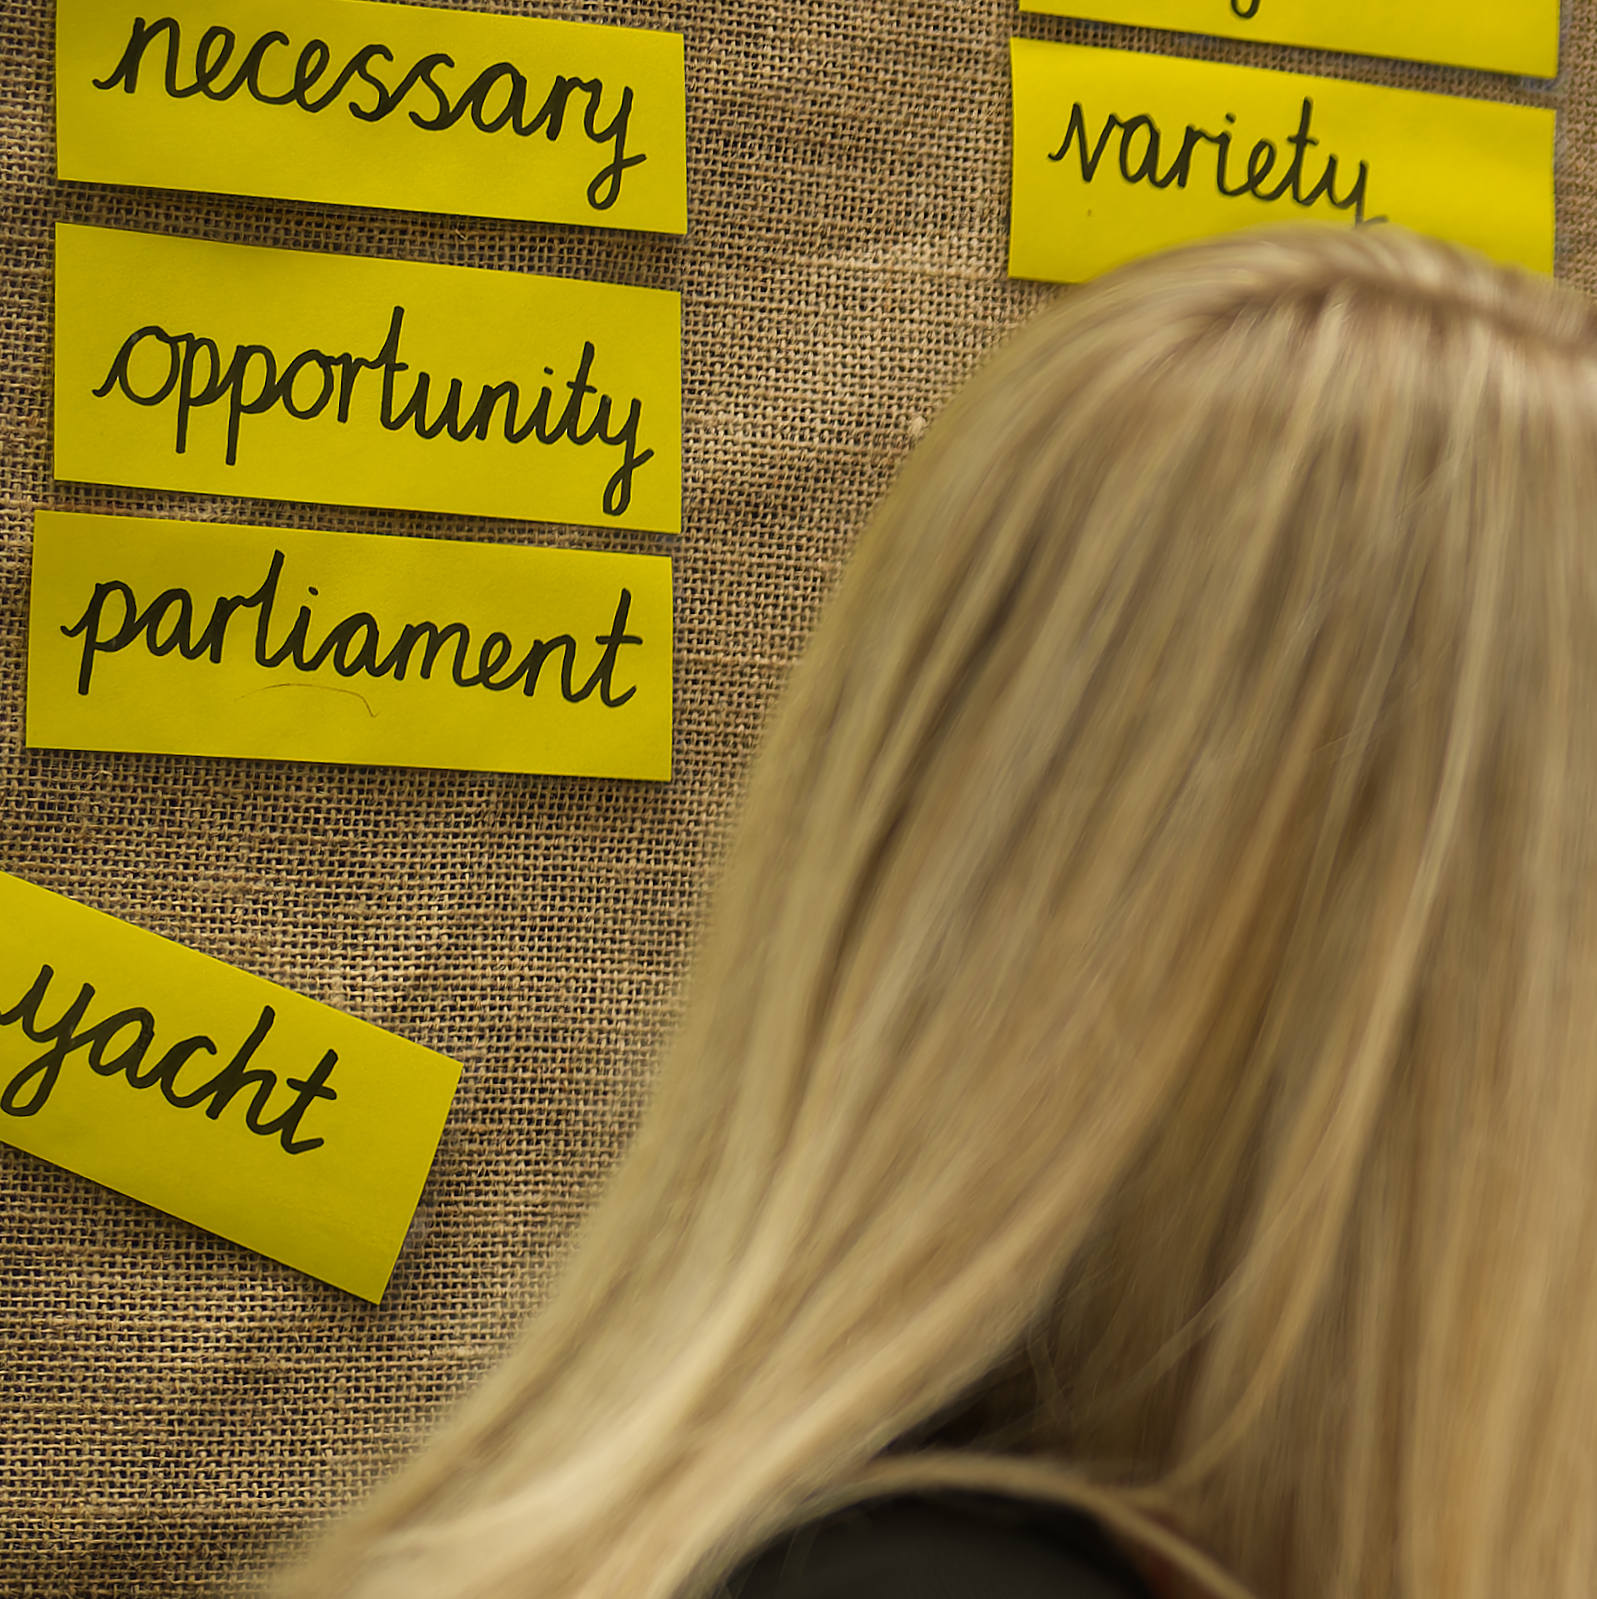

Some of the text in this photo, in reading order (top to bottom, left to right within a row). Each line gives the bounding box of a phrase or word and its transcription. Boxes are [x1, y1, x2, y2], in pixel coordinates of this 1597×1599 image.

[92, 16, 647, 211] necessary
[1047, 97, 1388, 229] variety
[92, 305, 655, 517] opportunity
[60, 549, 644, 708] parliament
[0, 964, 338, 1155] yacht
